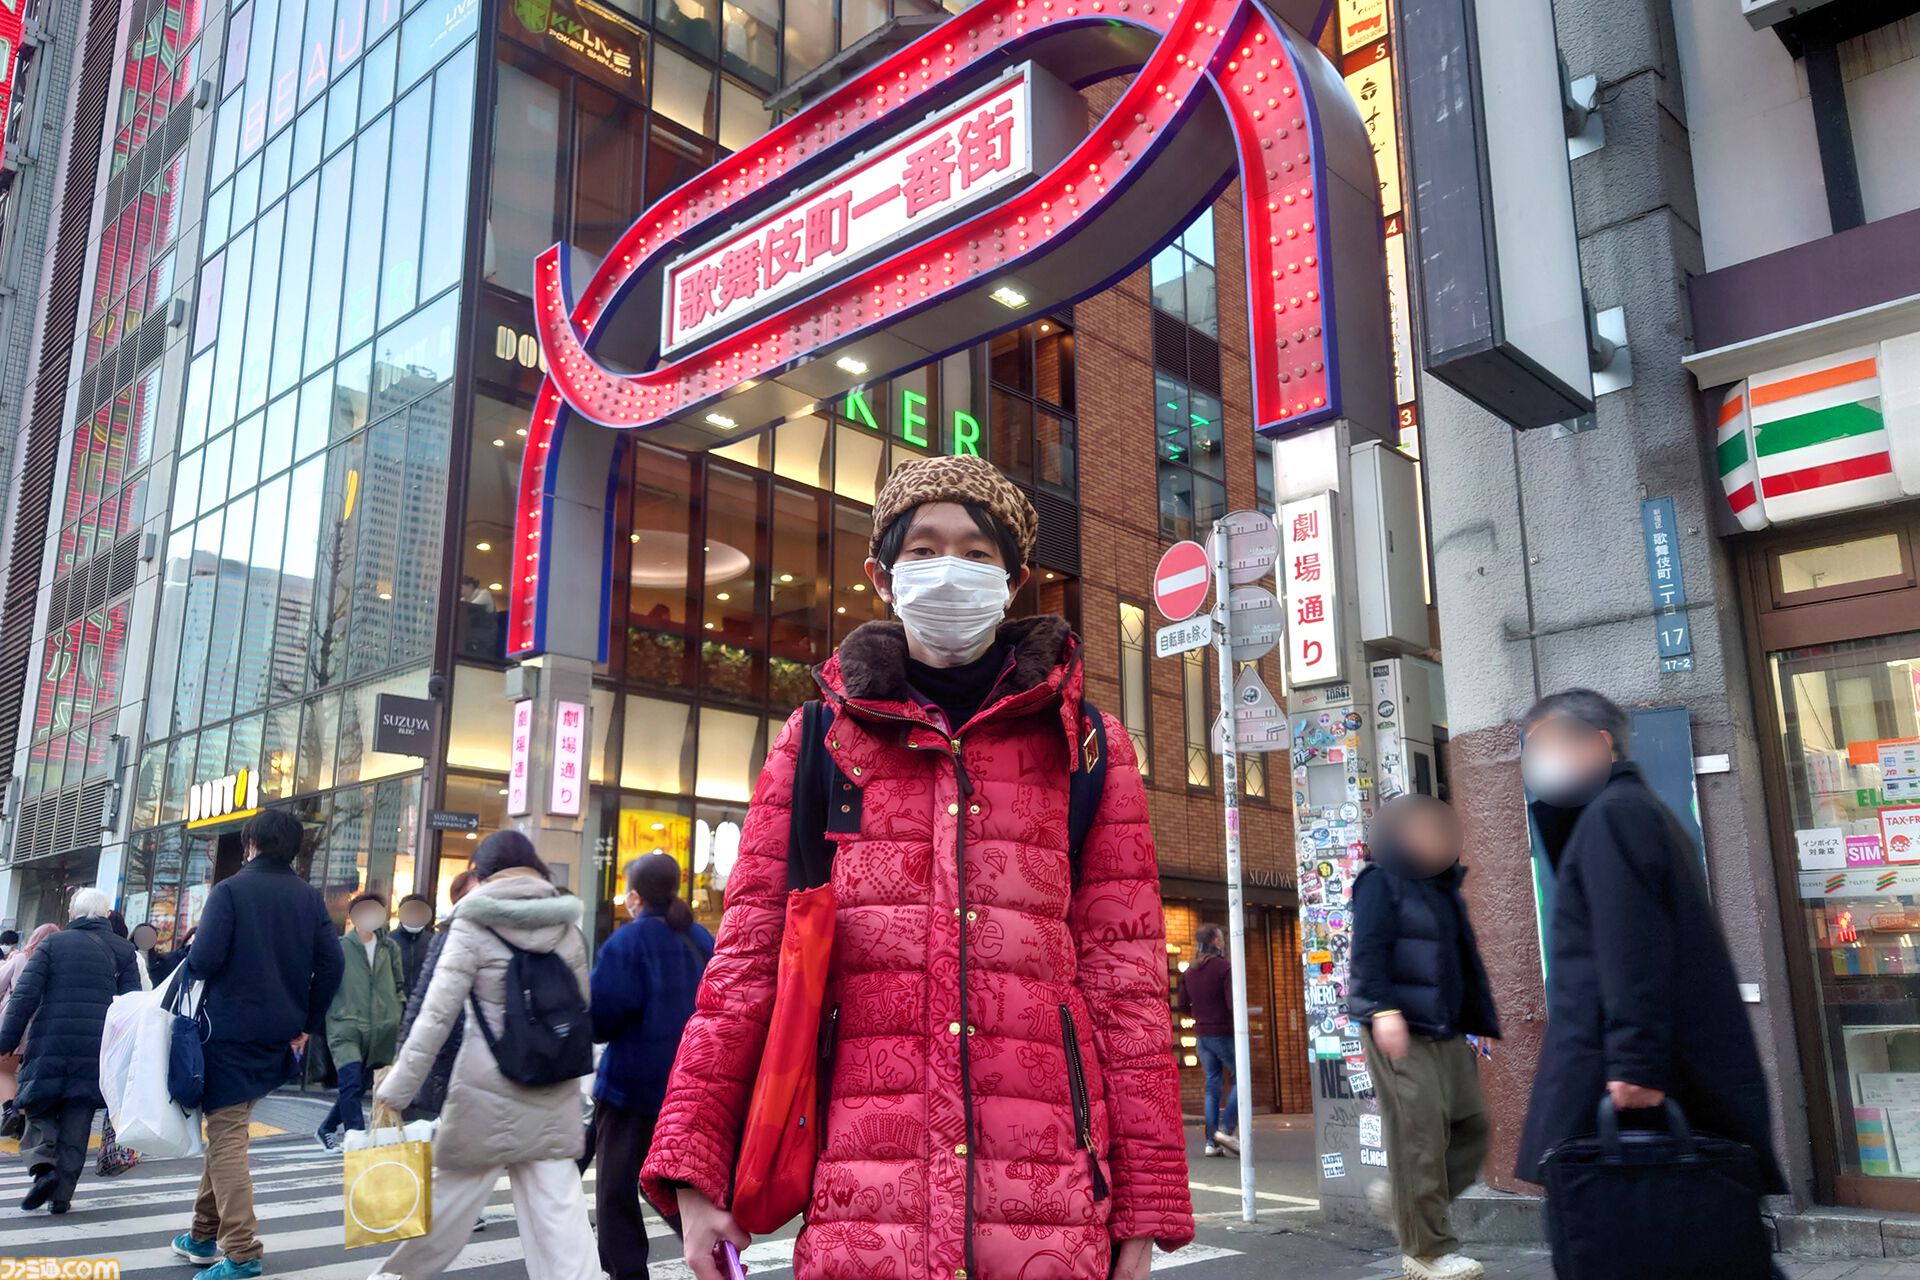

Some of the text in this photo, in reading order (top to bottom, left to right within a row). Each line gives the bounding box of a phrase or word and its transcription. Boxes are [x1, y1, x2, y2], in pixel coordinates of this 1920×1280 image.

[1375, 42, 1386, 60] 5
[678, 98, 1014, 331] 歌舞伎町一番街
[1386, 218, 1398, 235] 4
[1401, 409, 1412, 426] 3
[1653, 532, 1676, 616] 歌舞伎町一丁目
[1292, 510, 1325, 667] 劇場通り
[1160, 624, 1208, 652] 自転車を除く
[1661, 628, 1685, 648] 17
[1664, 658, 1691, 671] 17-2
[382, 714, 430, 731] SUZUYA
[560, 710, 579, 804] 劇場通り
[1803, 838, 1840, 848] インボイス
[1808, 847, 1836, 857] 対象店
[1848, 845, 1881, 862] SIM
[1249, 868, 1292, 889] SUZUYA
[1350, 1074, 1368, 1084] SPICY
[1352, 1081, 1371, 1091] MIKE
